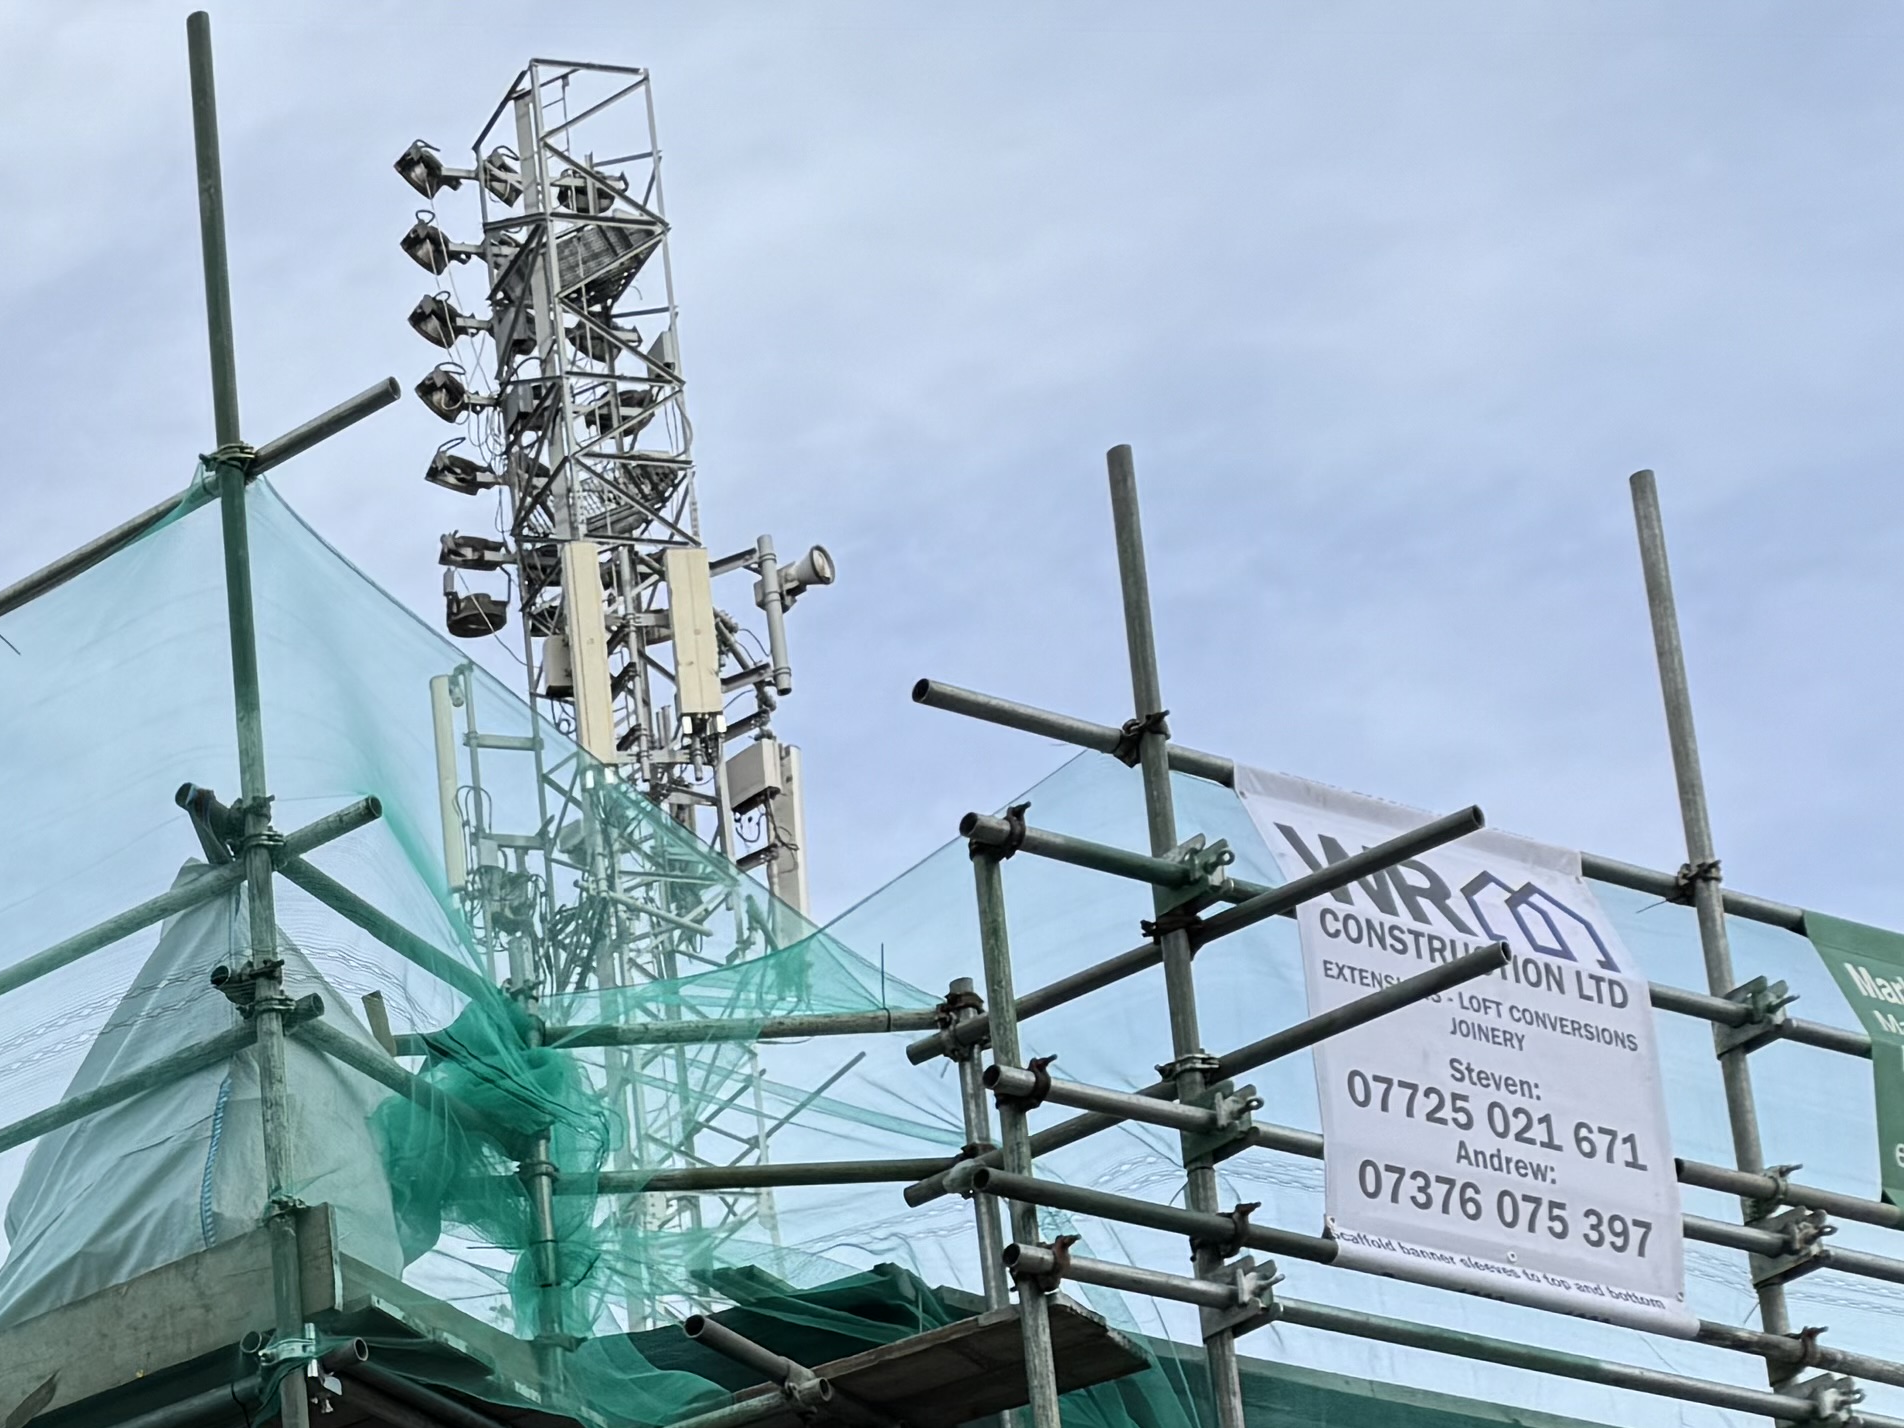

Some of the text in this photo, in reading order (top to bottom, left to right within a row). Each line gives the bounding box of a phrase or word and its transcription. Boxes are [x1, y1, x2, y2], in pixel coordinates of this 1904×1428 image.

[1575, 969, 1628, 1008] LTD
[1449, 1016, 1526, 1052] JOINERY
[1458, 991, 1502, 1019] LOFT
[1509, 1005, 1639, 1052] CONVERSIONS
[1449, 1058, 1541, 1100] Steven:
[1347, 1069, 1648, 1172] 07725 021 671
[1456, 1140, 1557, 1185] Andrew:
[1358, 1159, 1652, 1258] 07376 075 397
[1398, 1242, 1457, 1265] banner
[1522, 1269, 1542, 1284] to
[1543, 1273, 1572, 1291] top
[1573, 1282, 1605, 1297] and
[1606, 1286, 1666, 1310] bottom
